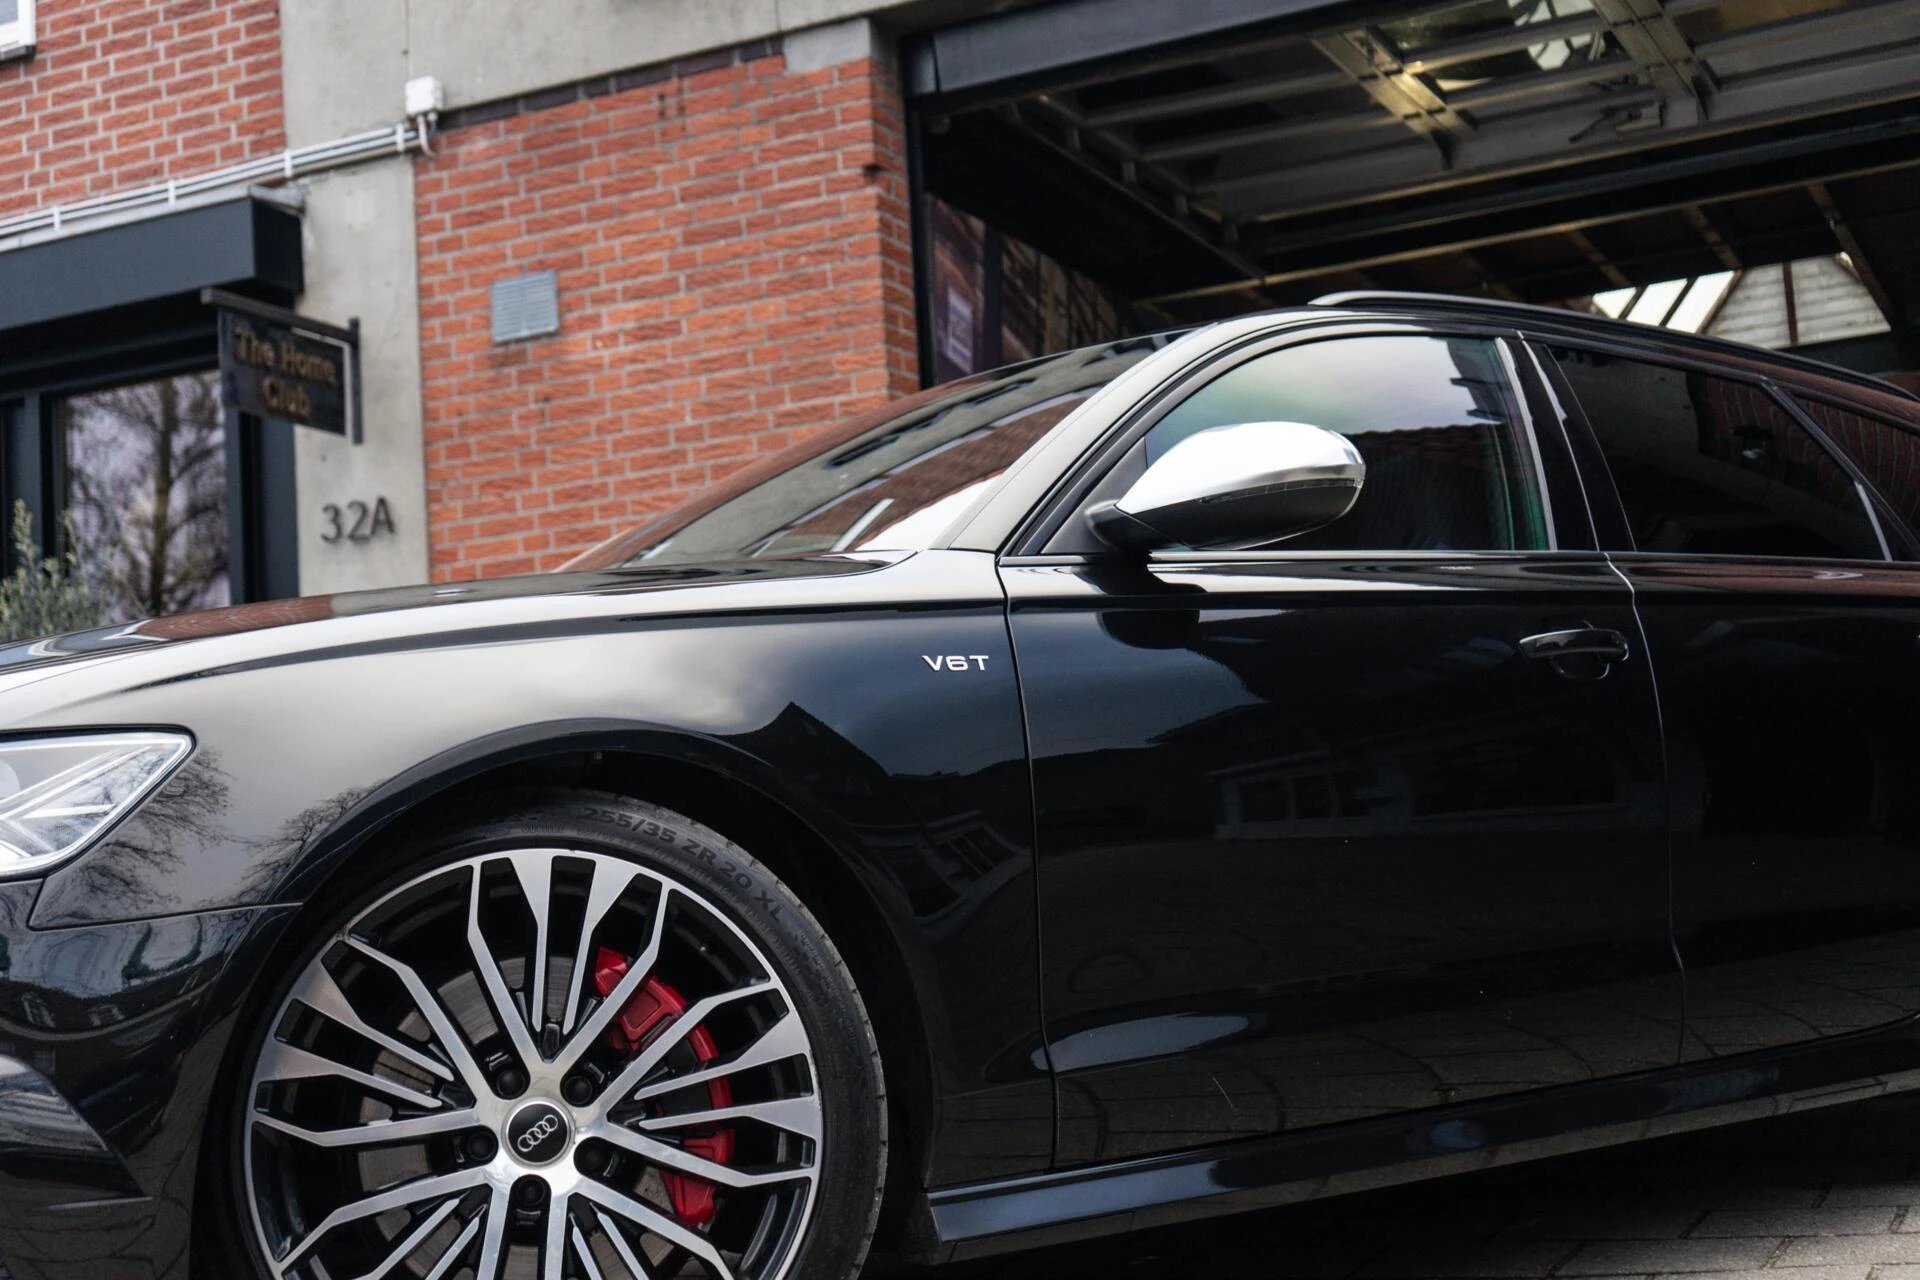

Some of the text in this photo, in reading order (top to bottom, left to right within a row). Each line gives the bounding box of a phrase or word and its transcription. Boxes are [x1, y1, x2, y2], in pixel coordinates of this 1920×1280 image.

[235, 327, 336, 381] The Home
[264, 378, 310, 415] Club
[320, 496, 395, 544] 32A
[922, 655, 989, 671] V6T
[583, 807, 785, 922] 255/35 ZR 20 XL
